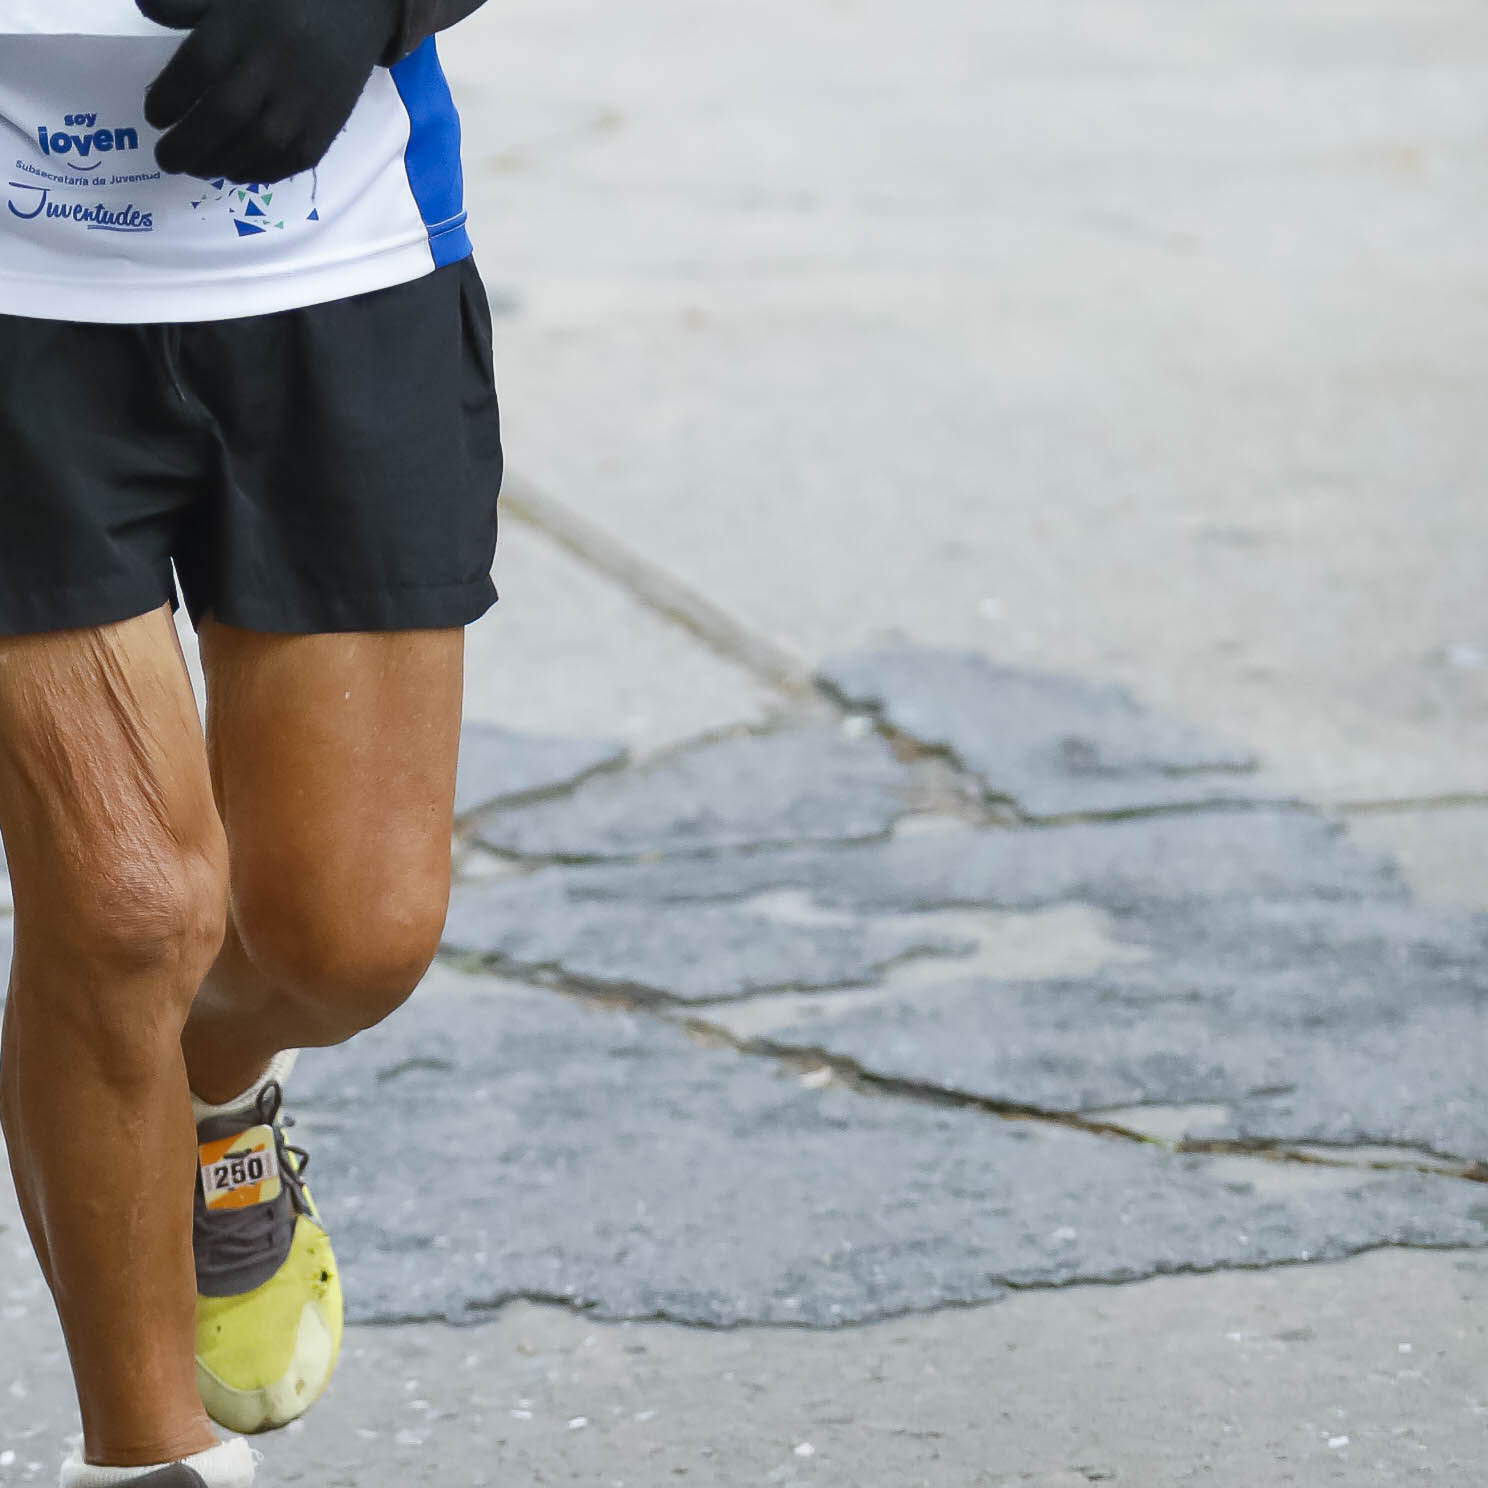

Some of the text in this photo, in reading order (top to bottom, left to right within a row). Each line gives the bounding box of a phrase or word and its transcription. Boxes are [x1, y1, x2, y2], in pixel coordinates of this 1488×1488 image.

[64, 112, 97, 128] soy
[92, 175, 106, 186] de
[109, 171, 161, 185] Juventud
[8, 181, 153, 228] Juventudes
[215, 1157, 263, 1189] 250
